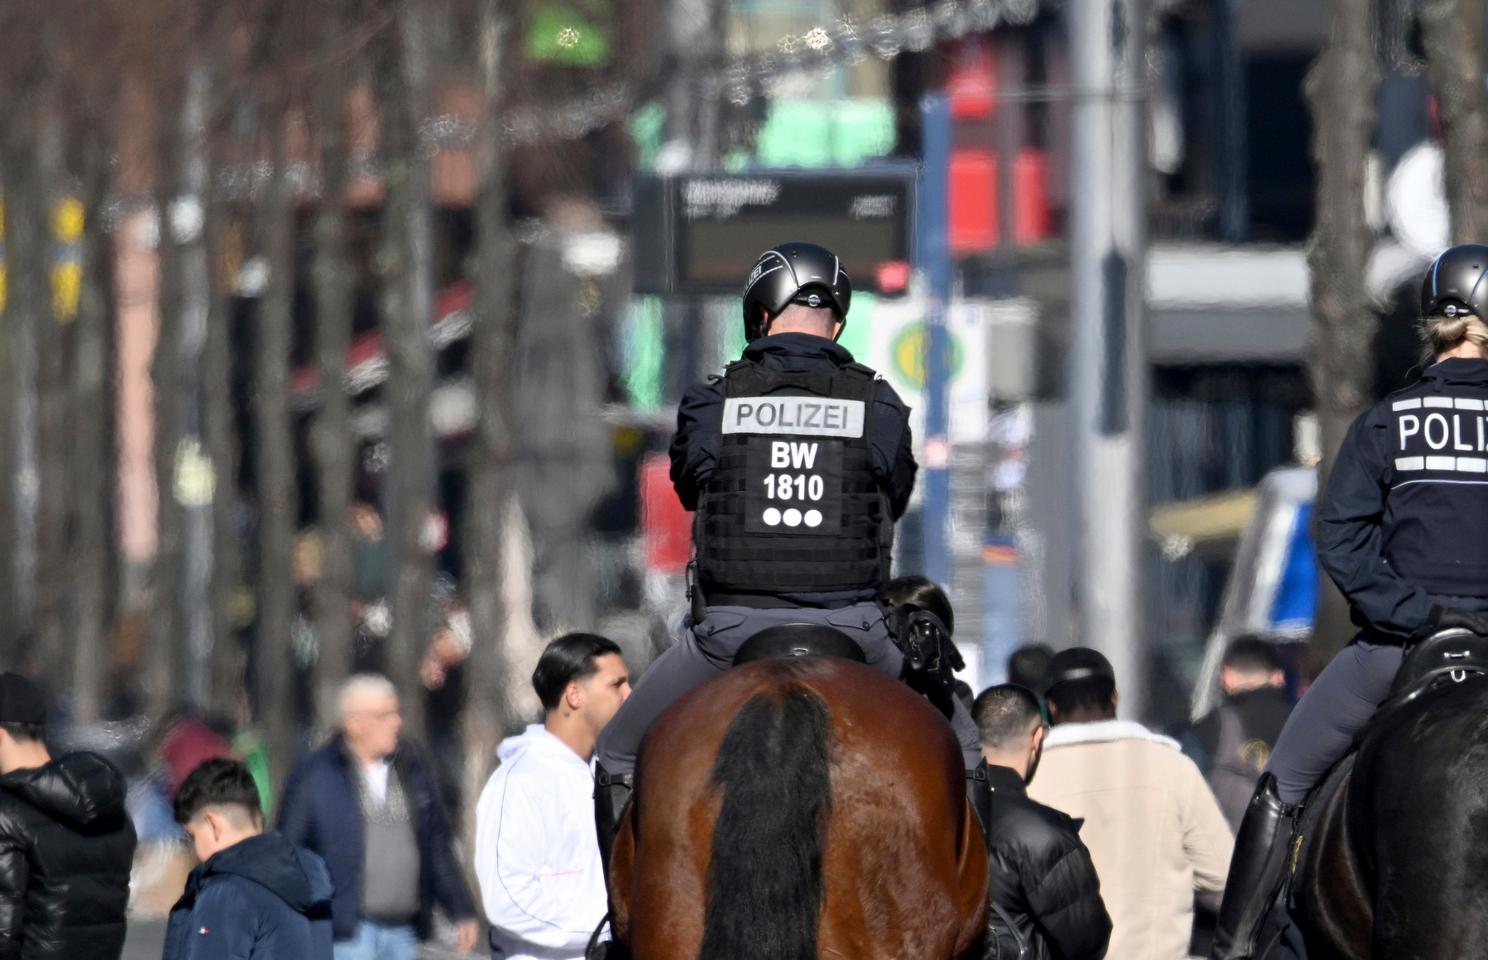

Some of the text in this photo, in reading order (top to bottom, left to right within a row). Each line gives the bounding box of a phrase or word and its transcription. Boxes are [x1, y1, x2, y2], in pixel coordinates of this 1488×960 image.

[736, 402, 848, 430] POLIZEI
[771, 441, 818, 470] BW
[763, 474, 824, 501] 1810
